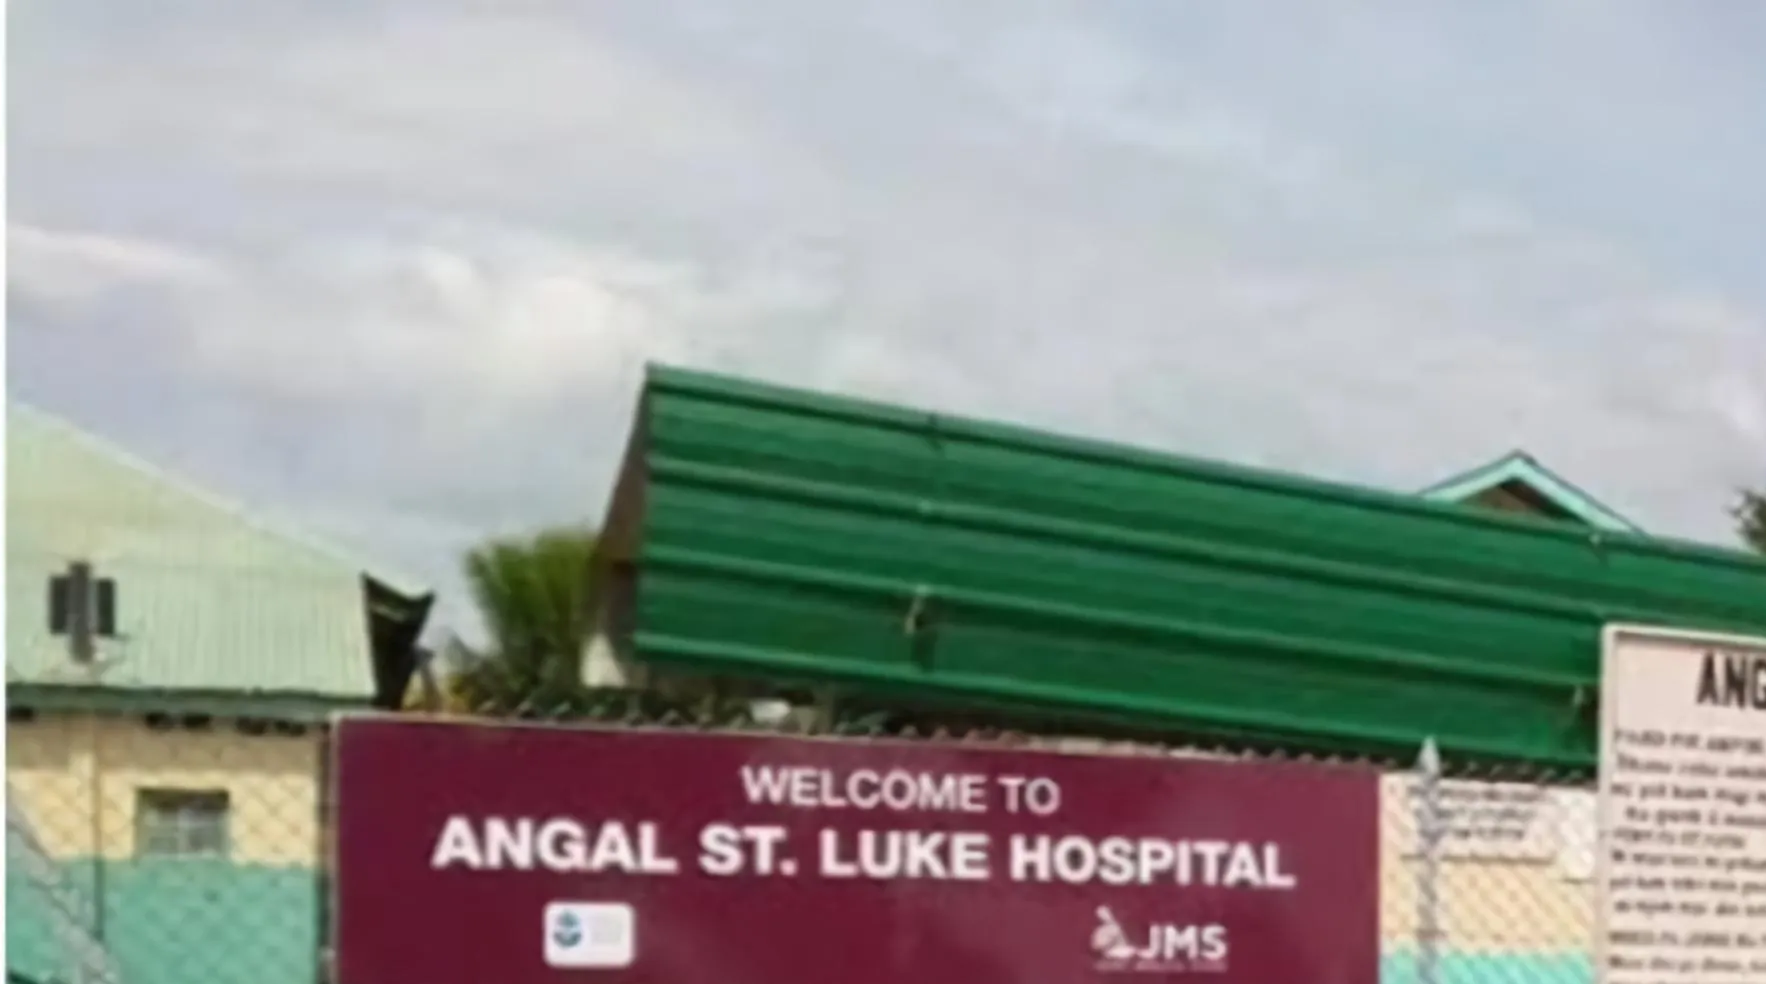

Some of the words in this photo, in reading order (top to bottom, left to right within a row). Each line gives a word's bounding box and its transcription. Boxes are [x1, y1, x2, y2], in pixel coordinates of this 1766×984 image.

[741, 764, 988, 813] WELCOME
[997, 776, 1061, 816] TO
[431, 815, 680, 874] ANGAL
[699, 823, 797, 876] ST.
[819, 828, 991, 881] LUKE
[1009, 834, 1297, 889] HOSPITAL
[1135, 923, 1228, 961] JMS
